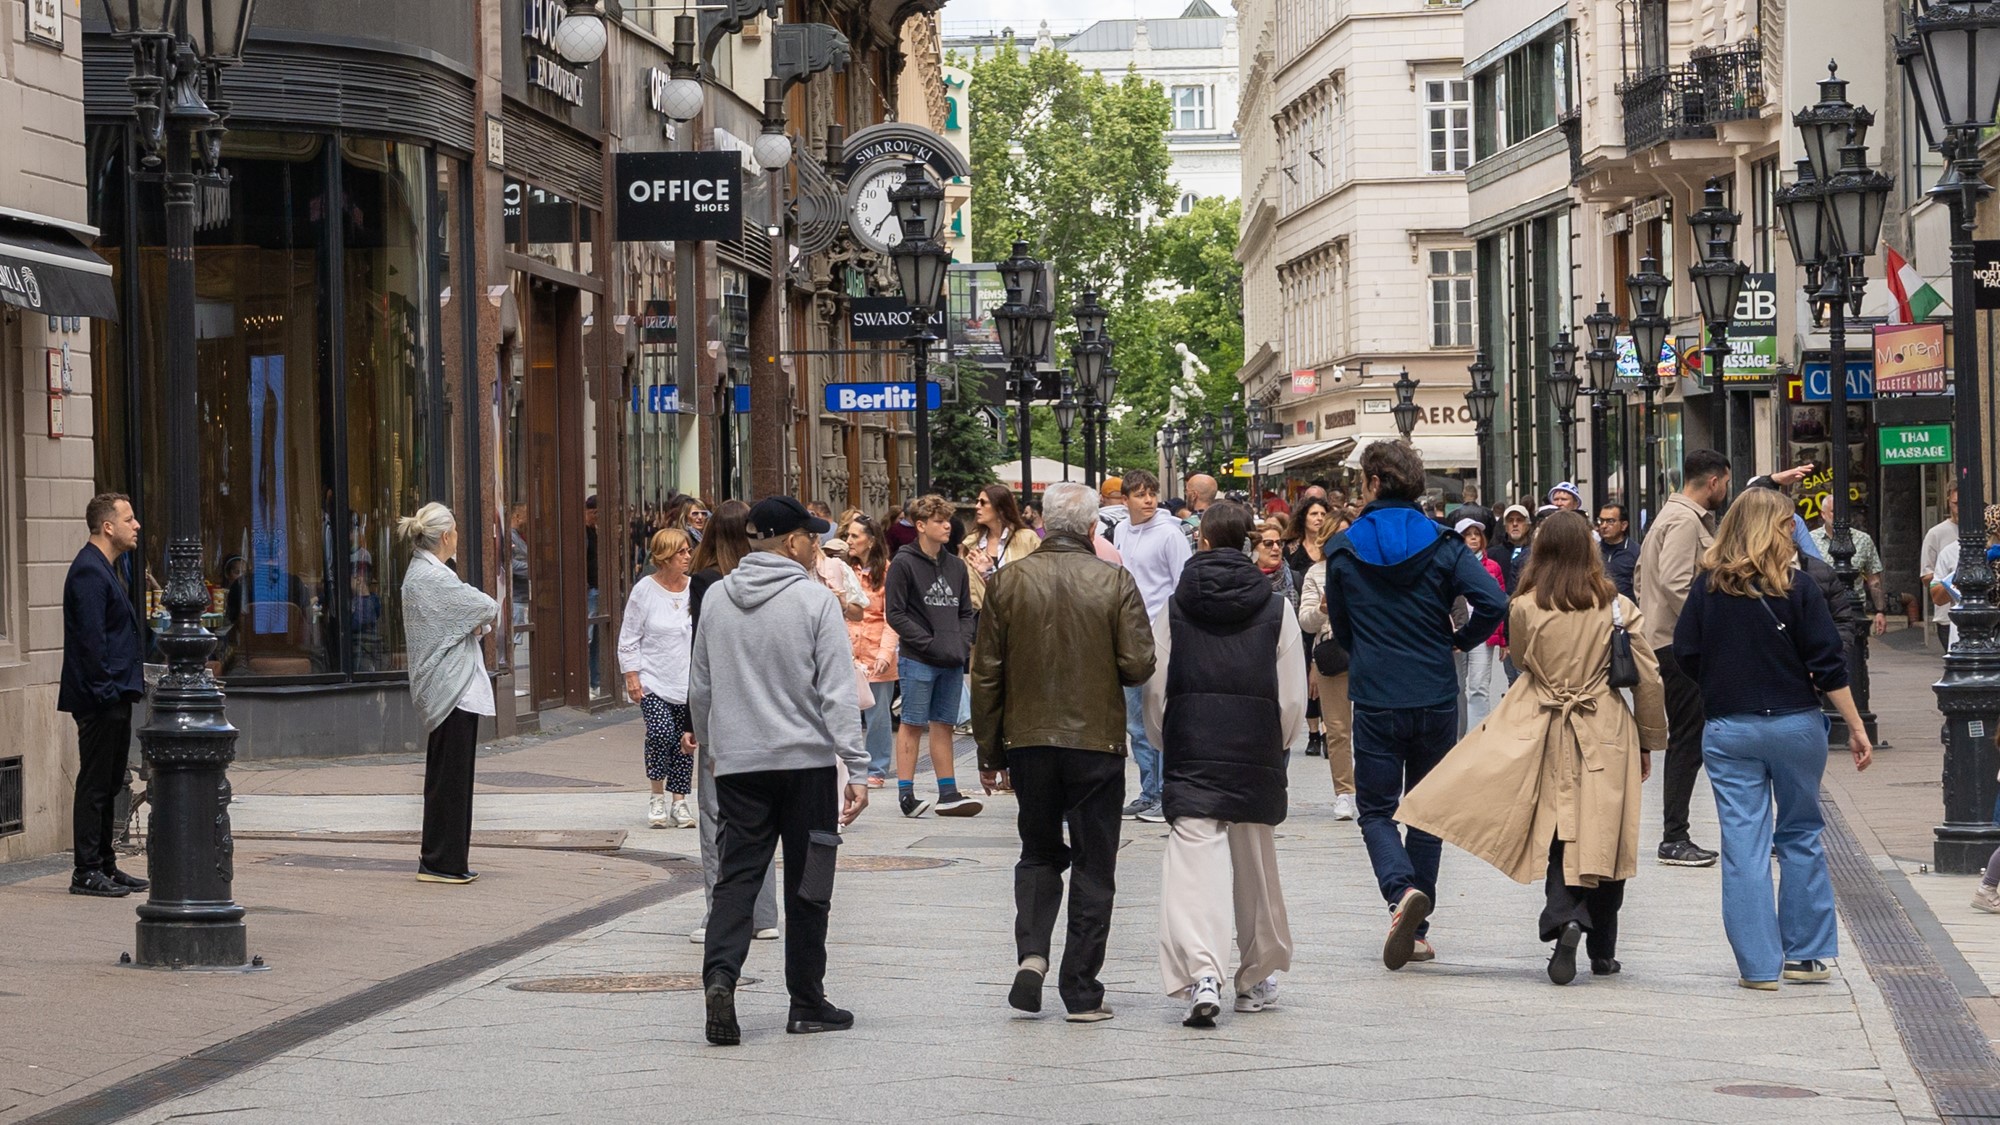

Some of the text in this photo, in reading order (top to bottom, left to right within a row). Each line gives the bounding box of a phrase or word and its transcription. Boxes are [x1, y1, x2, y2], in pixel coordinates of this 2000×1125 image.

[855, 140, 934, 165] SWAROVKI
[890, 175, 902, 184] 12
[629, 179, 730, 203] OFFICE
[866, 189, 877, 199] 10
[694, 203, 730, 212] SHOES
[861, 202, 868, 212] 9
[864, 217, 871, 226] 8
[888, 233, 896, 243] 6
[1988, 261, 2000, 270] TH
[1973, 270, 2000, 279] NORT
[1723, 355, 1770, 368] ASSAGE
[1916, 370, 1944, 389] SHOPS
[1899, 431, 1929, 444] THAI
[1885, 445, 1945, 459] MASSAGE
[923, 594, 960, 607] adidas
